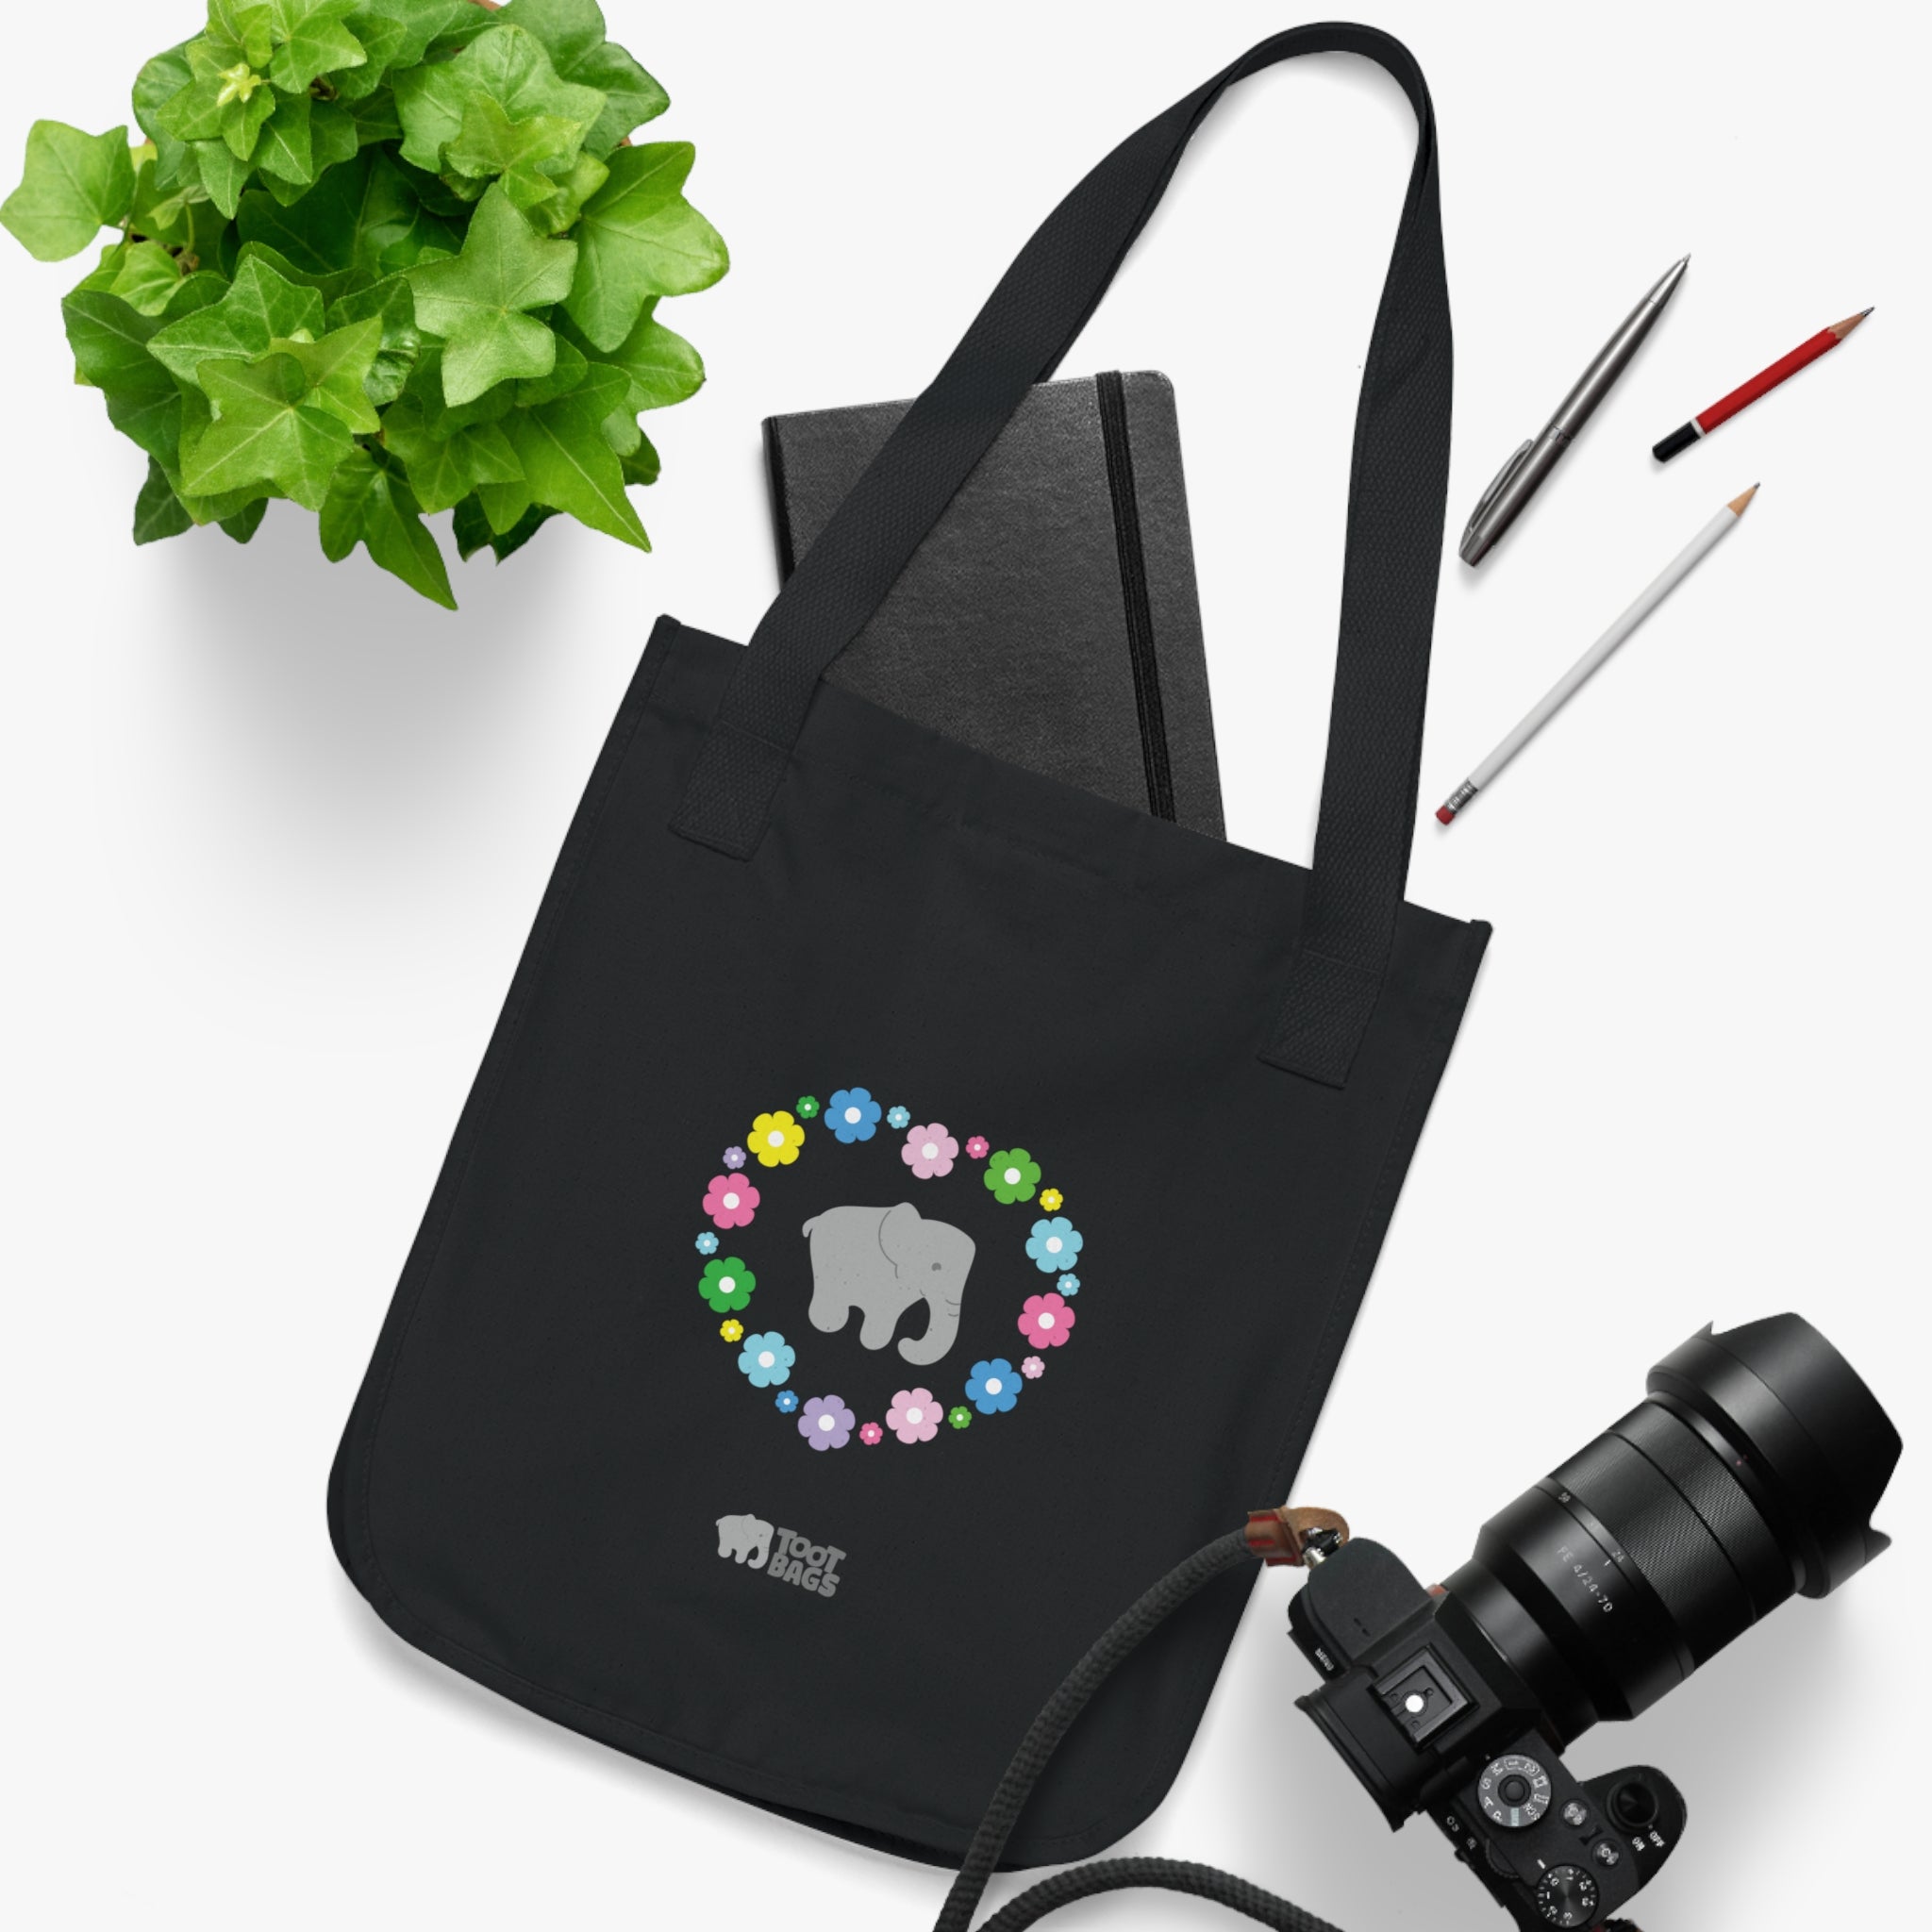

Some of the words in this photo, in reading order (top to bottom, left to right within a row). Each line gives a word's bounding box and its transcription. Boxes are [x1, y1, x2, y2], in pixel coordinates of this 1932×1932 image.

[776, 1526, 847, 1574] TOOT
[1557, 1545, 1574, 1563] FE
[767, 1552, 841, 1597] BAGS
